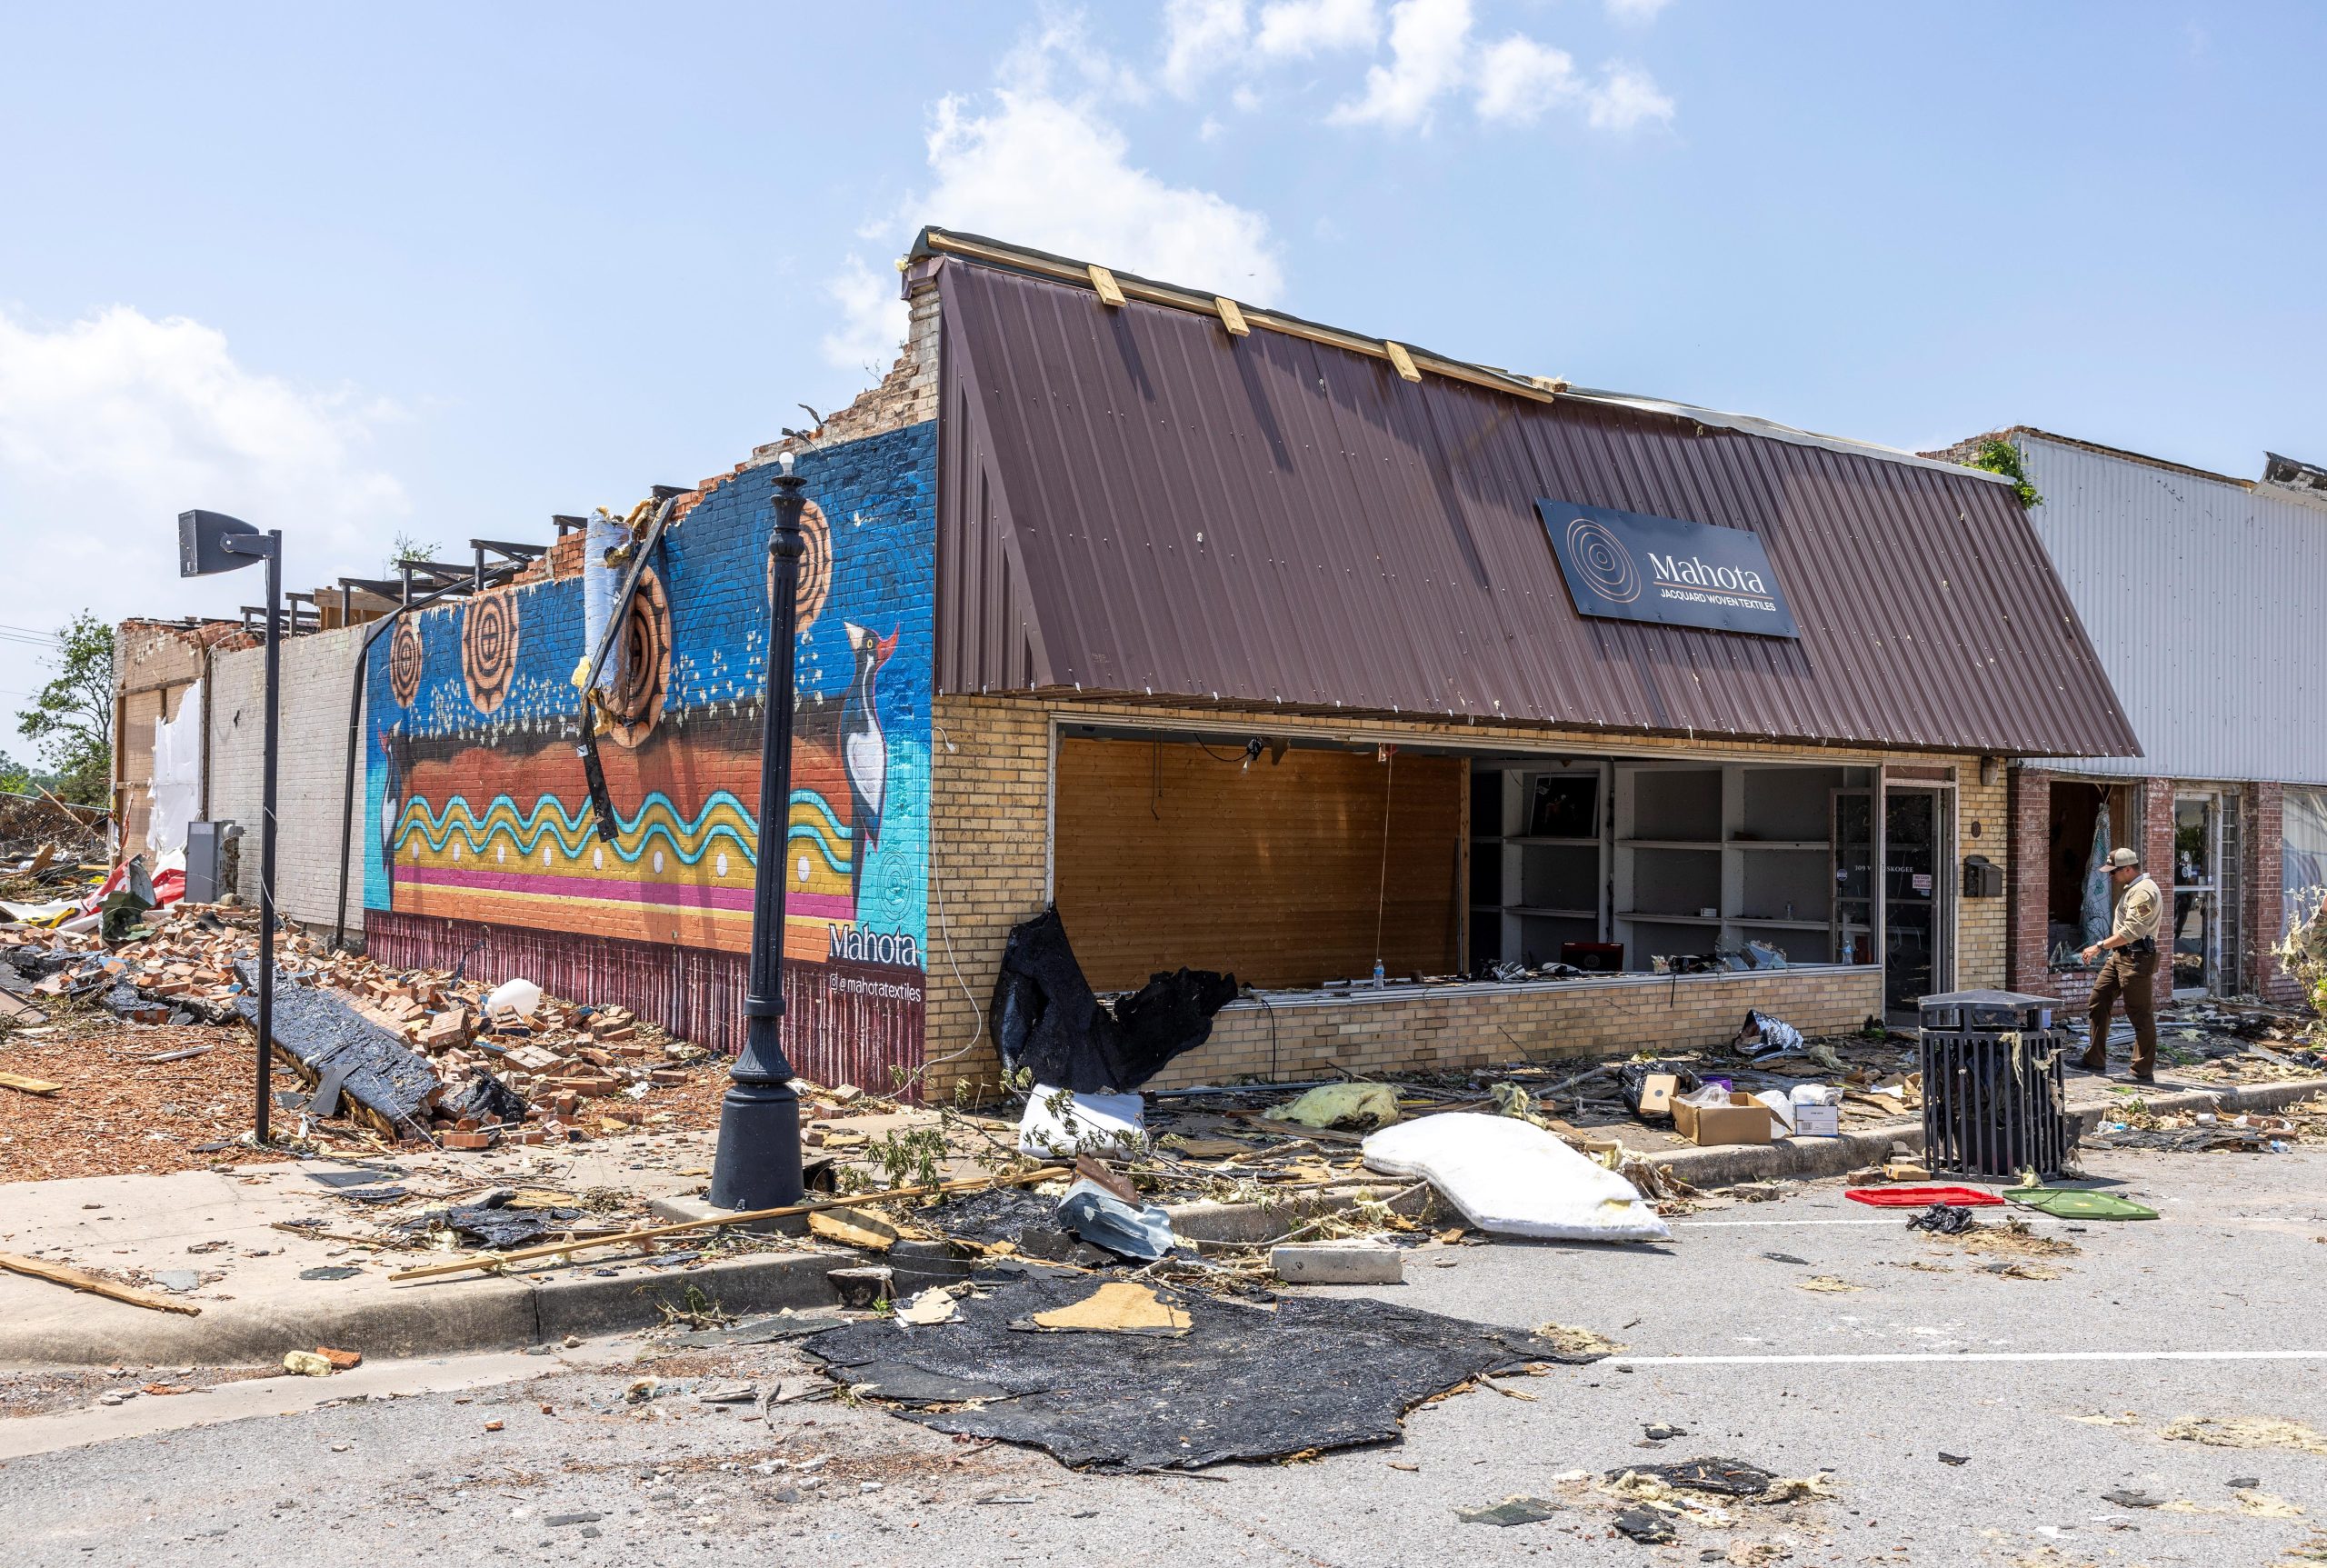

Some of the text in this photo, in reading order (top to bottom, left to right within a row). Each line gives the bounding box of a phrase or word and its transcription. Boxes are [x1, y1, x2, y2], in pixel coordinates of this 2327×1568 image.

[1647, 552, 1767, 594] Mahota
[1660, 588, 1776, 612] JACQUARD WOVEN TEXTILES
[828, 922, 918, 966] Mahota
[839, 975, 921, 1003] @mahotatextiles
